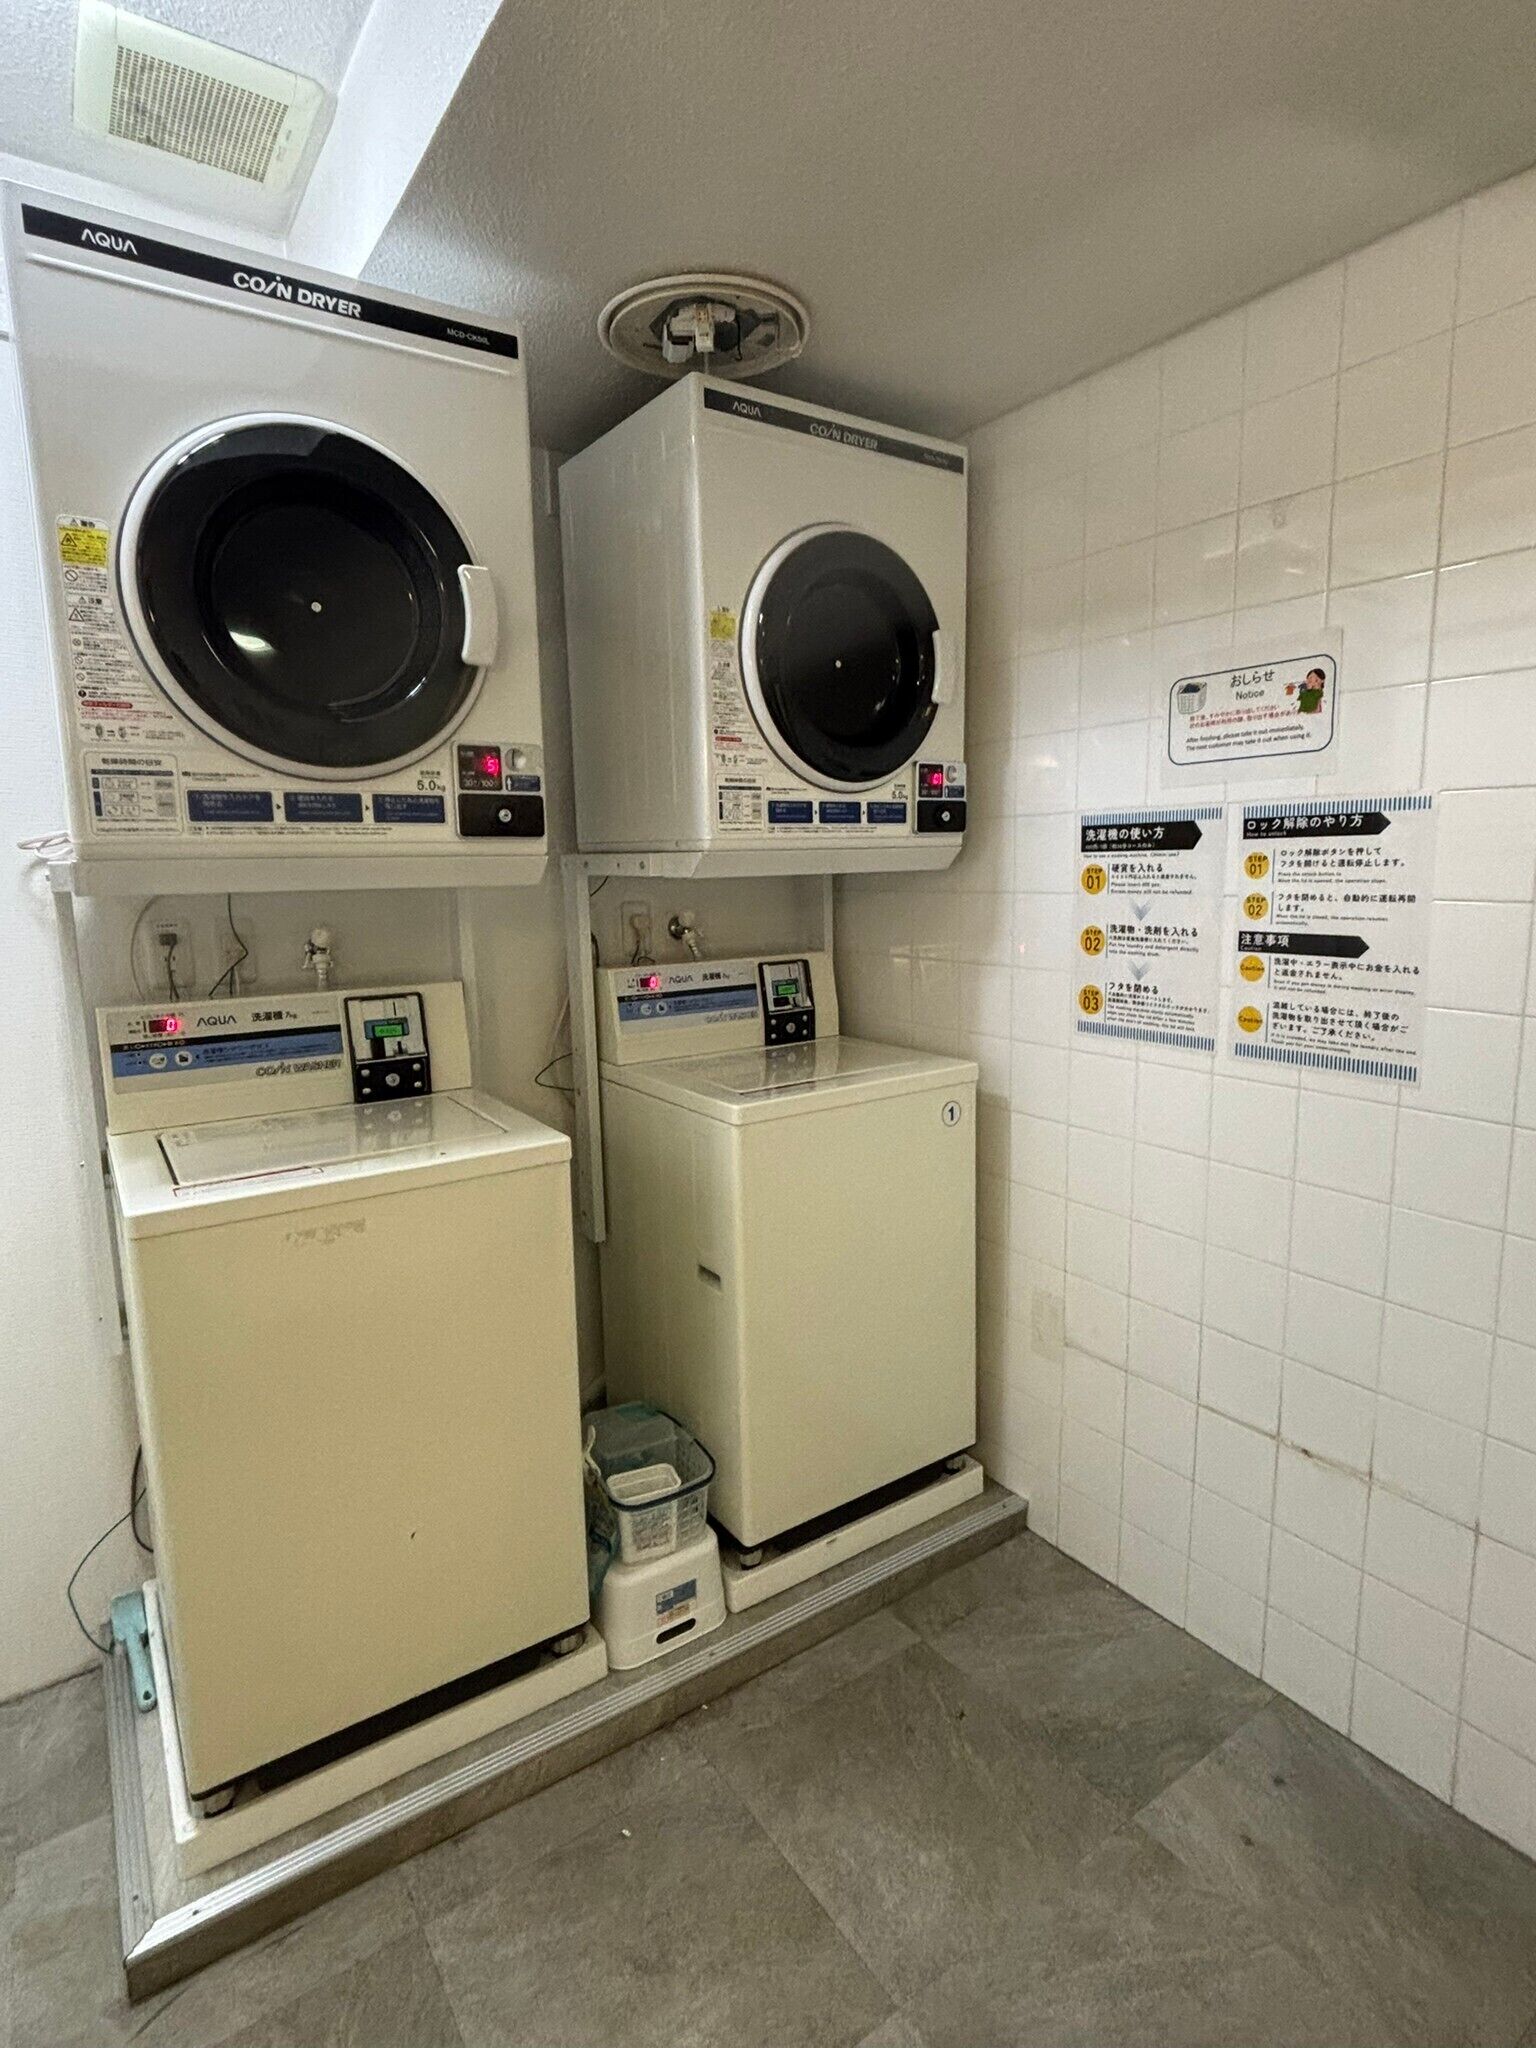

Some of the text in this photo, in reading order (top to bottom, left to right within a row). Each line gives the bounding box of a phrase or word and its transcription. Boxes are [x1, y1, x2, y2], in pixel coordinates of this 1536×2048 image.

[81, 227, 138, 256] AQUA
[232, 271, 292, 301] COIN
[297, 286, 363, 319] DRYER
[733, 401, 762, 418] AQUA
[843, 431, 878, 450] DRYER
[1230, 669, 1275, 688] おしらせ
[1235, 689, 1265, 701] Notice
[1246, 815, 1364, 830] ロック解除のやり方
[1086, 827, 1165, 841] 洗濯機の使い方
[1280, 847, 1382, 857] ロック解除ボタンを押して
[1112, 863, 1163, 873] 硬貨を入れる
[1250, 864, 1262, 875] 01
[1280, 859, 1405, 868] フタを開けると運転停止します。
[1086, 876, 1101, 889] 01
[1277, 893, 1416, 903] フタを閉めると、自動的に運転再開
[1248, 905, 1263, 916] 02
[1278, 904, 1305, 912] します。
[1110, 924, 1198, 937] 洗濯物・洗剤を入れる
[1085, 937, 1100, 951] 02
[1241, 933, 1290, 947] 注意事項
[1274, 958, 1420, 975] 洗濯中・エラー表示中にお金を入れる
[669, 975, 693, 984] AQUA
[1274, 969, 1343, 981] と返金されません。
[1109, 983, 1159, 995] フタを閉める
[1083, 997, 1099, 1011] 03
[1272, 1001, 1400, 1021] 混雑している場合には、終了後の
[197, 1014, 237, 1027] AQUA
[252, 1011, 283, 1022] 洗濯機
[1272, 1012, 1409, 1034] 洗濯物を取り出させて頂く場合がご
[1272, 1022, 1375, 1042] ざいます。ご了承ください。
[948, 1105, 954, 1121] 1
